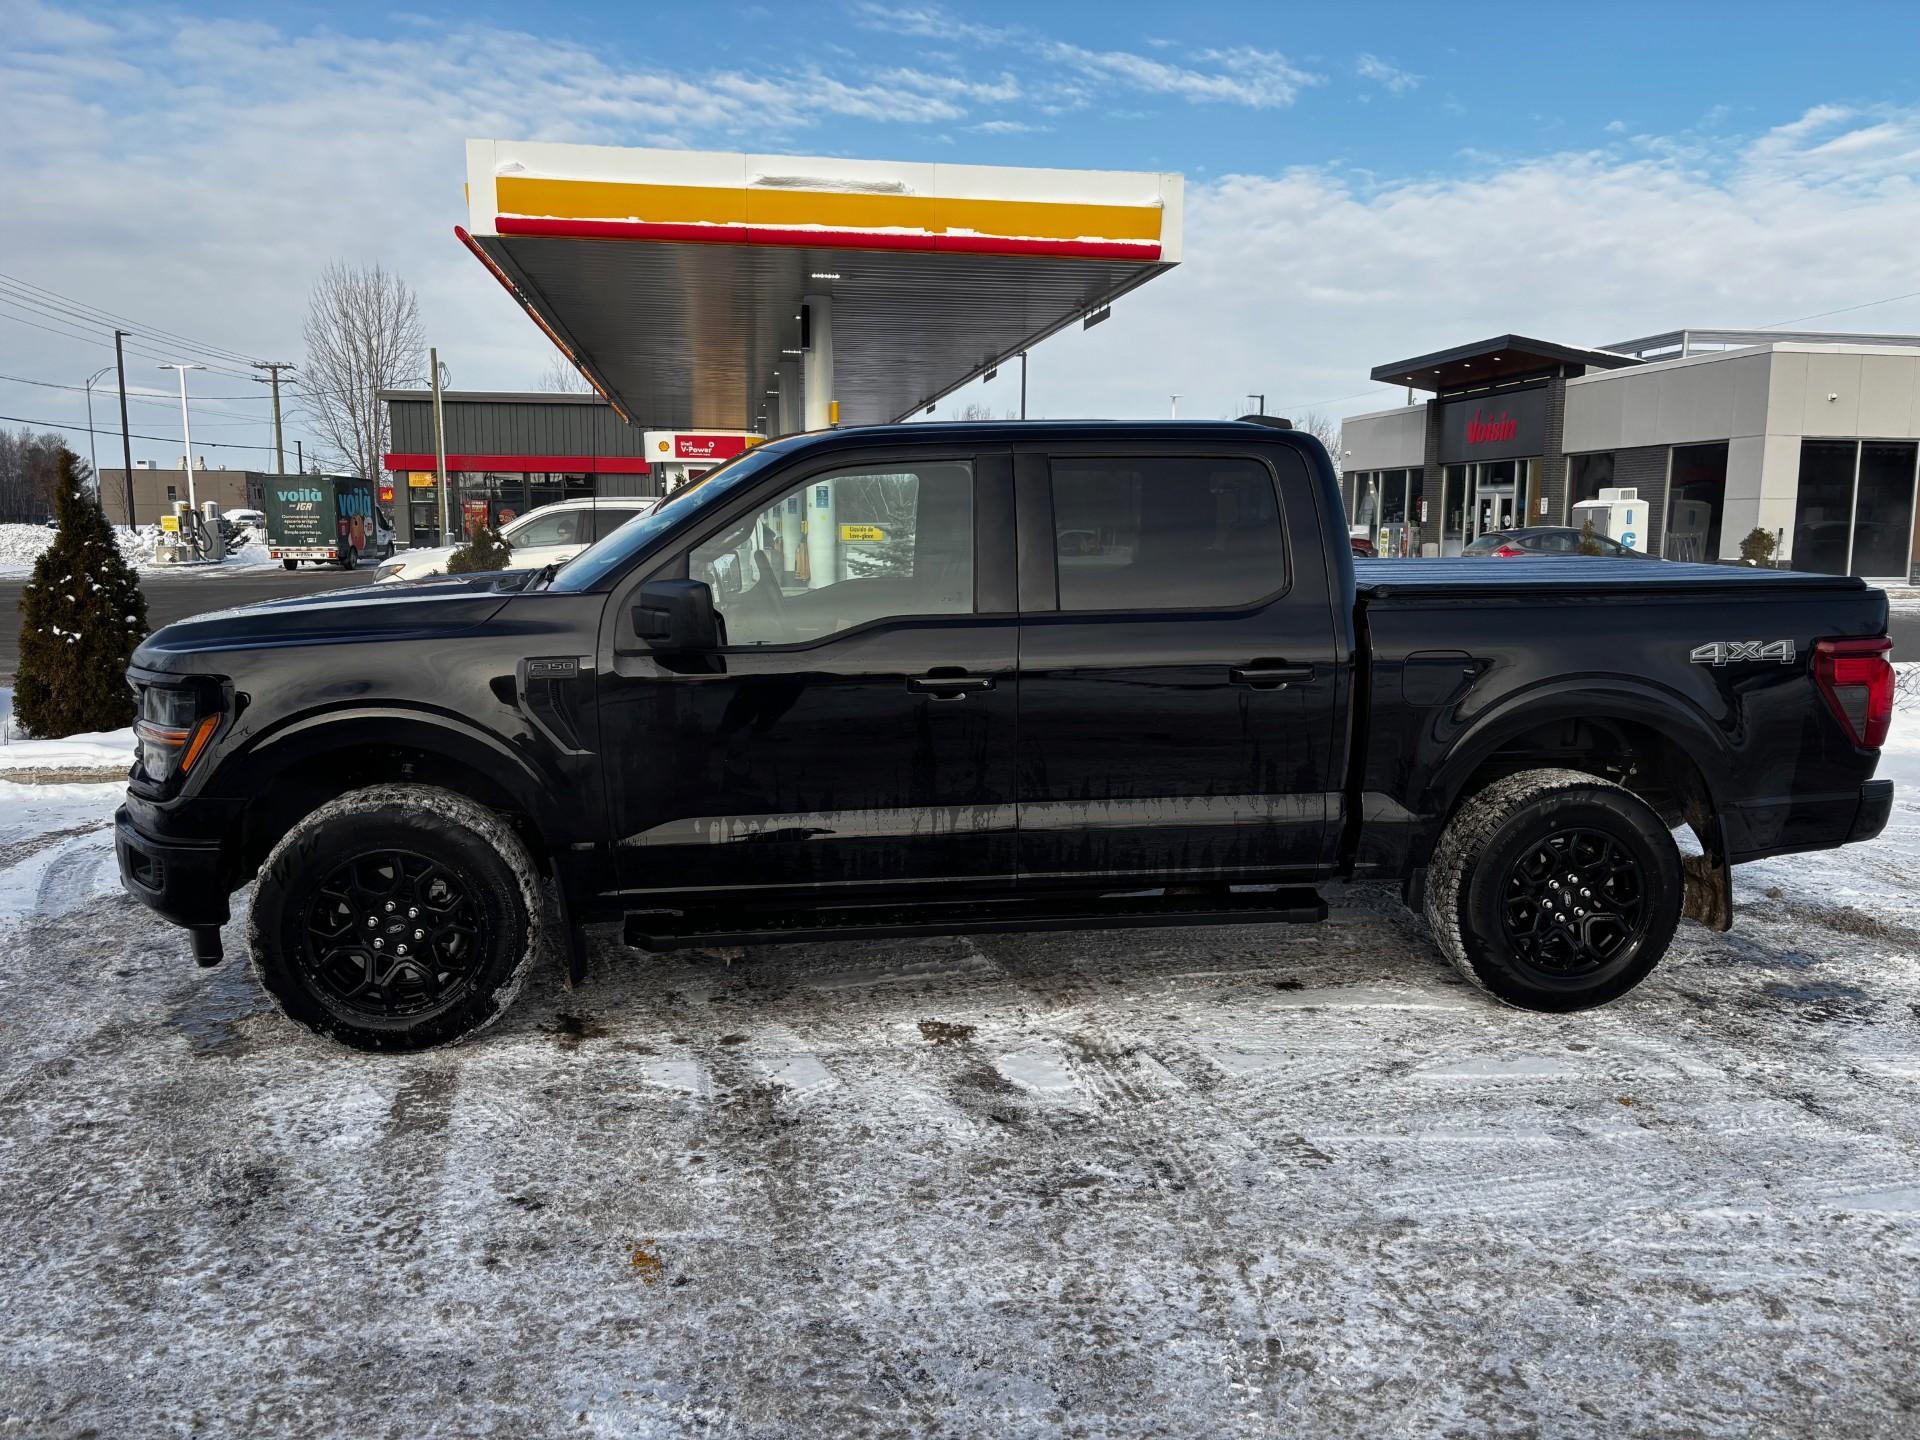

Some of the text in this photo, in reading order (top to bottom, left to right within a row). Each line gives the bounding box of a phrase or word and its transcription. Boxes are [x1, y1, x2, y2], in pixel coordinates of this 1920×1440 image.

[1467, 408, 1517, 444] Voisin
[277, 487, 322, 502] voilà
[295, 502, 313, 511] IGA
